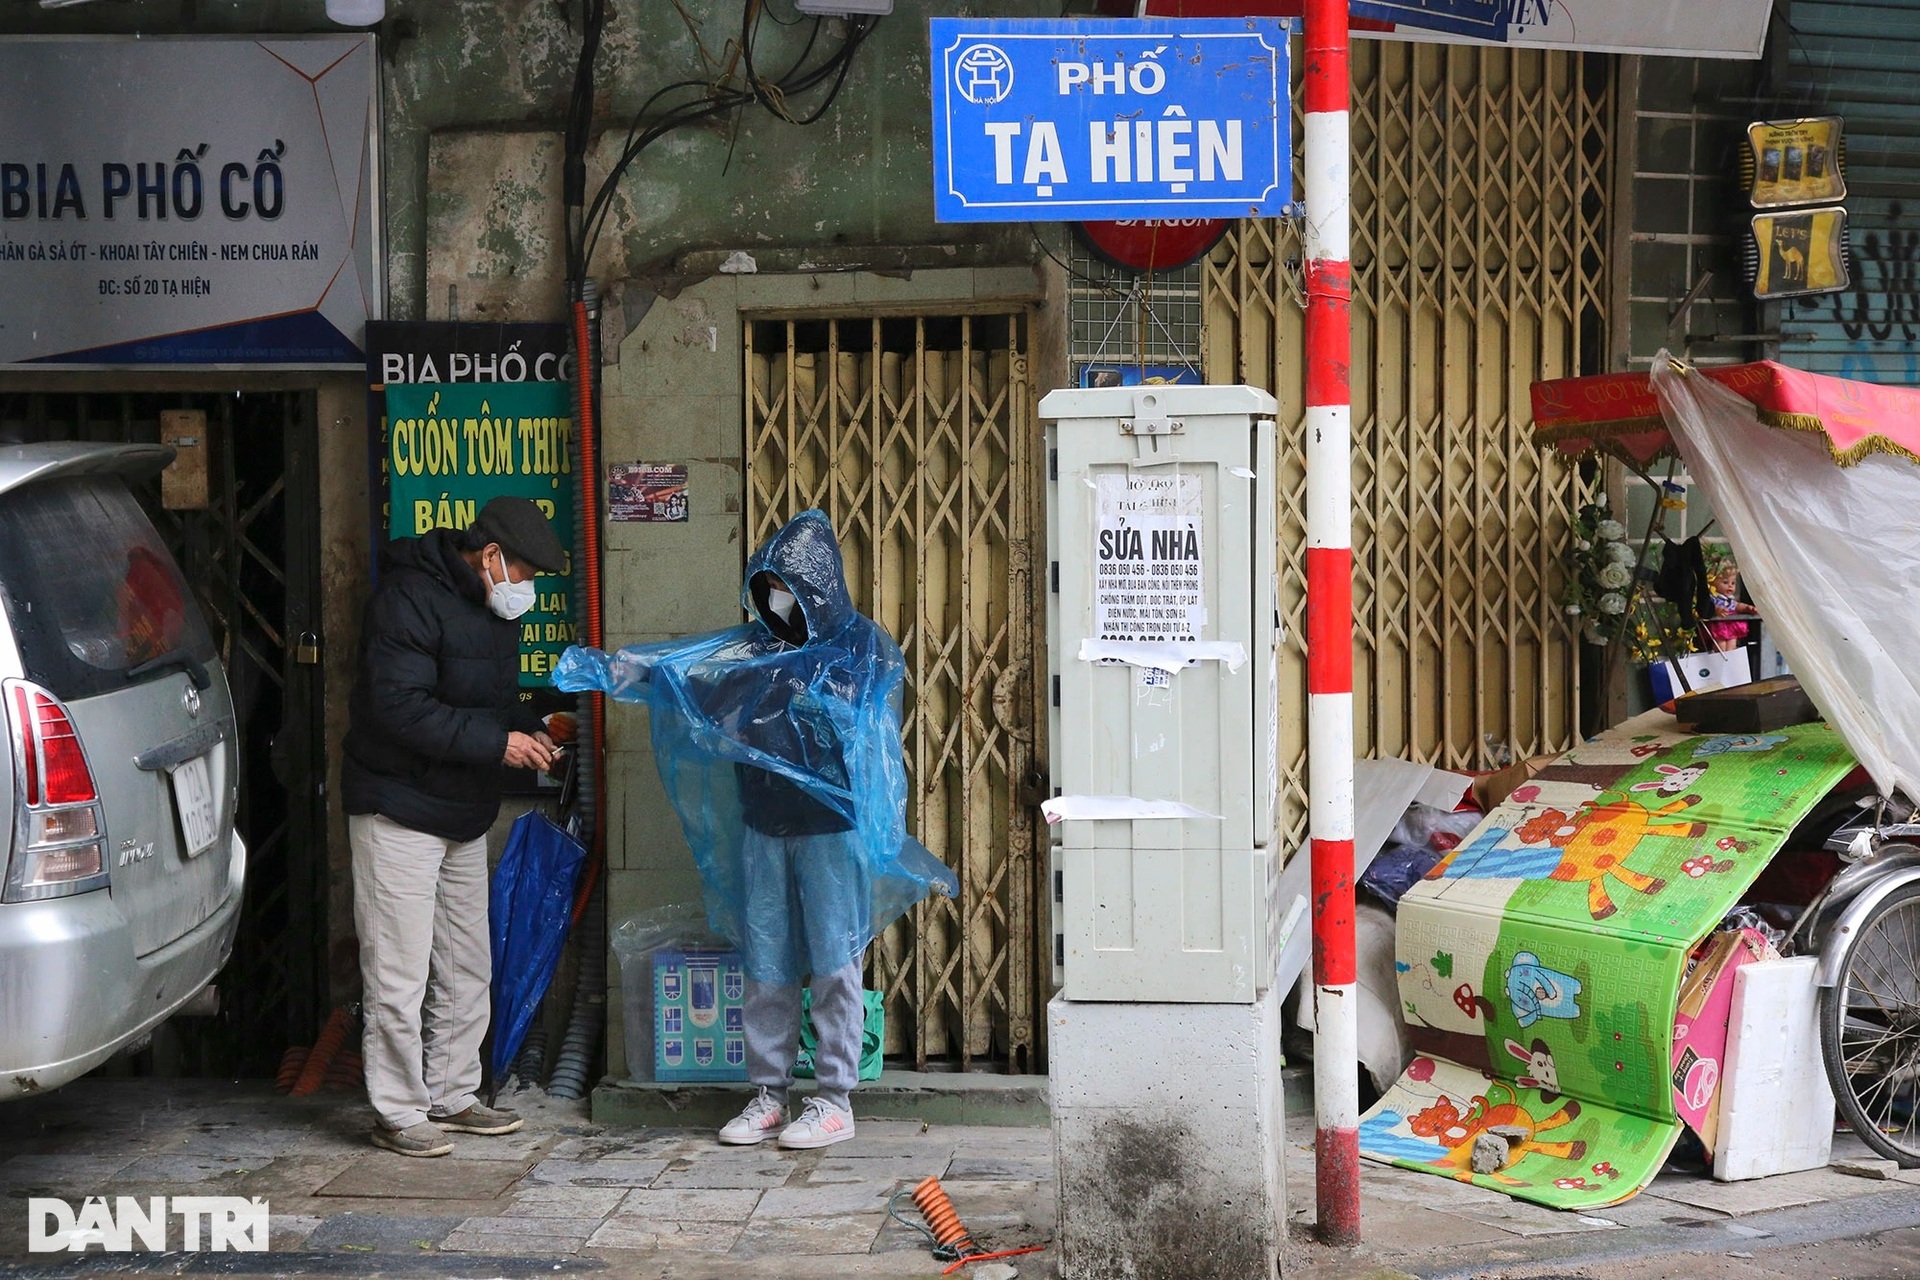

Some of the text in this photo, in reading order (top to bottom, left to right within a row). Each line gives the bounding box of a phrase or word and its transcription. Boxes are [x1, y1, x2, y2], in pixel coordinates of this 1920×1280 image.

[1058, 46, 1168, 95] PHỐ
[984, 105, 1243, 197] TẠ HIỆN
[0, 138, 286, 221] BIA PHỐ CỔ
[28, 240, 46, 261] GÀ
[49, 239, 67, 261] SẢ
[70, 240, 87, 261] ỚT
[100, 244, 139, 261] KHOAI
[142, 242, 166, 261] TÂY
[169, 242, 208, 261] CHIÊN
[221, 245, 249, 261] NEM
[252, 245, 289, 261] CHUA
[291, 242, 319, 261] RÁN
[124, 275, 142, 295] SỐ
[144, 279, 159, 295] 20
[161, 279, 179, 297] TẠ
[181, 276, 211, 297] HIỆN
[382, 353, 442, 384] BIA
[449, 340, 528, 384] PHỐ
[392, 391, 573, 489] CUỐN TÔM THỊT
[414, 492, 475, 535] BÁN
[1099, 516, 1199, 561] SỬA NHÀ
[1099, 563, 1117, 576] 0836
[1118, 563, 1130, 576] 050
[1132, 563, 1145, 576] 456
[1151, 564, 1169, 576] 0836
[1170, 564, 1183, 576] 050
[1184, 564, 1198, 576] 456
[540, 593, 567, 615] LẠI
[519, 620, 577, 646] ẠI ĐÂY
